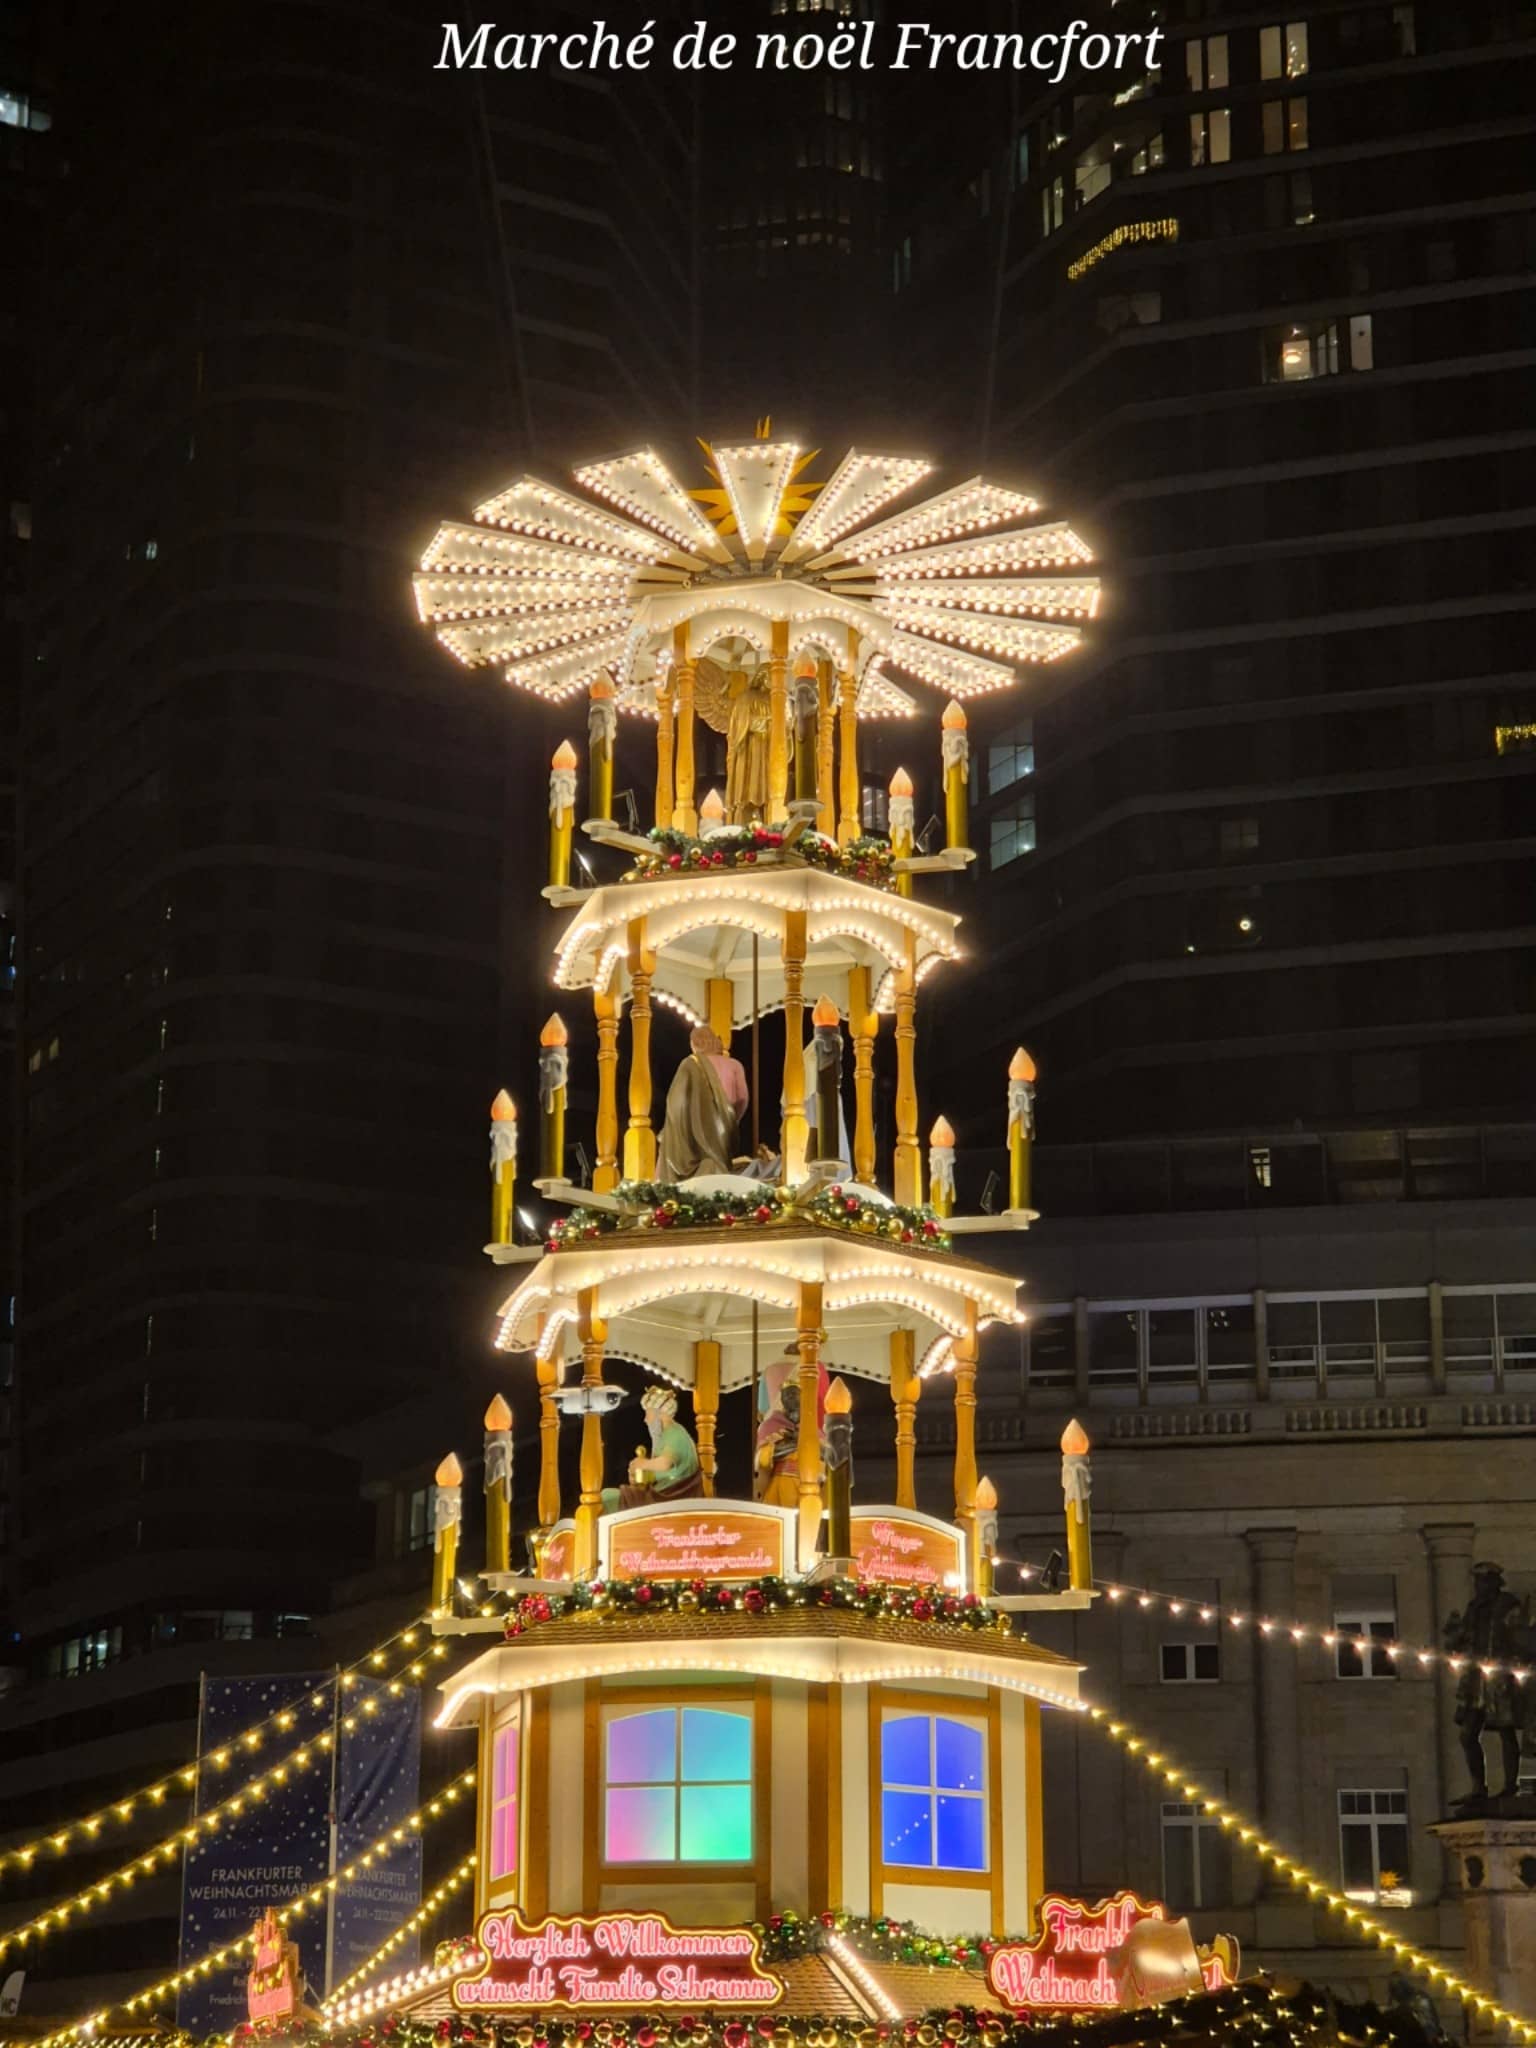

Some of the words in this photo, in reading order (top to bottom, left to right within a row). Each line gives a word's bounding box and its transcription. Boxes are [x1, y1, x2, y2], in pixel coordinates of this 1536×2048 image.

[211, 1866, 303, 1882] FRANKFURTER
[484, 1914, 590, 1965] Herzlich
[594, 1919, 753, 1957] Willkommen
[458, 1966, 555, 2003] wünscht
[558, 1965, 657, 2002] Familie
[657, 1965, 777, 2000] Schramm
